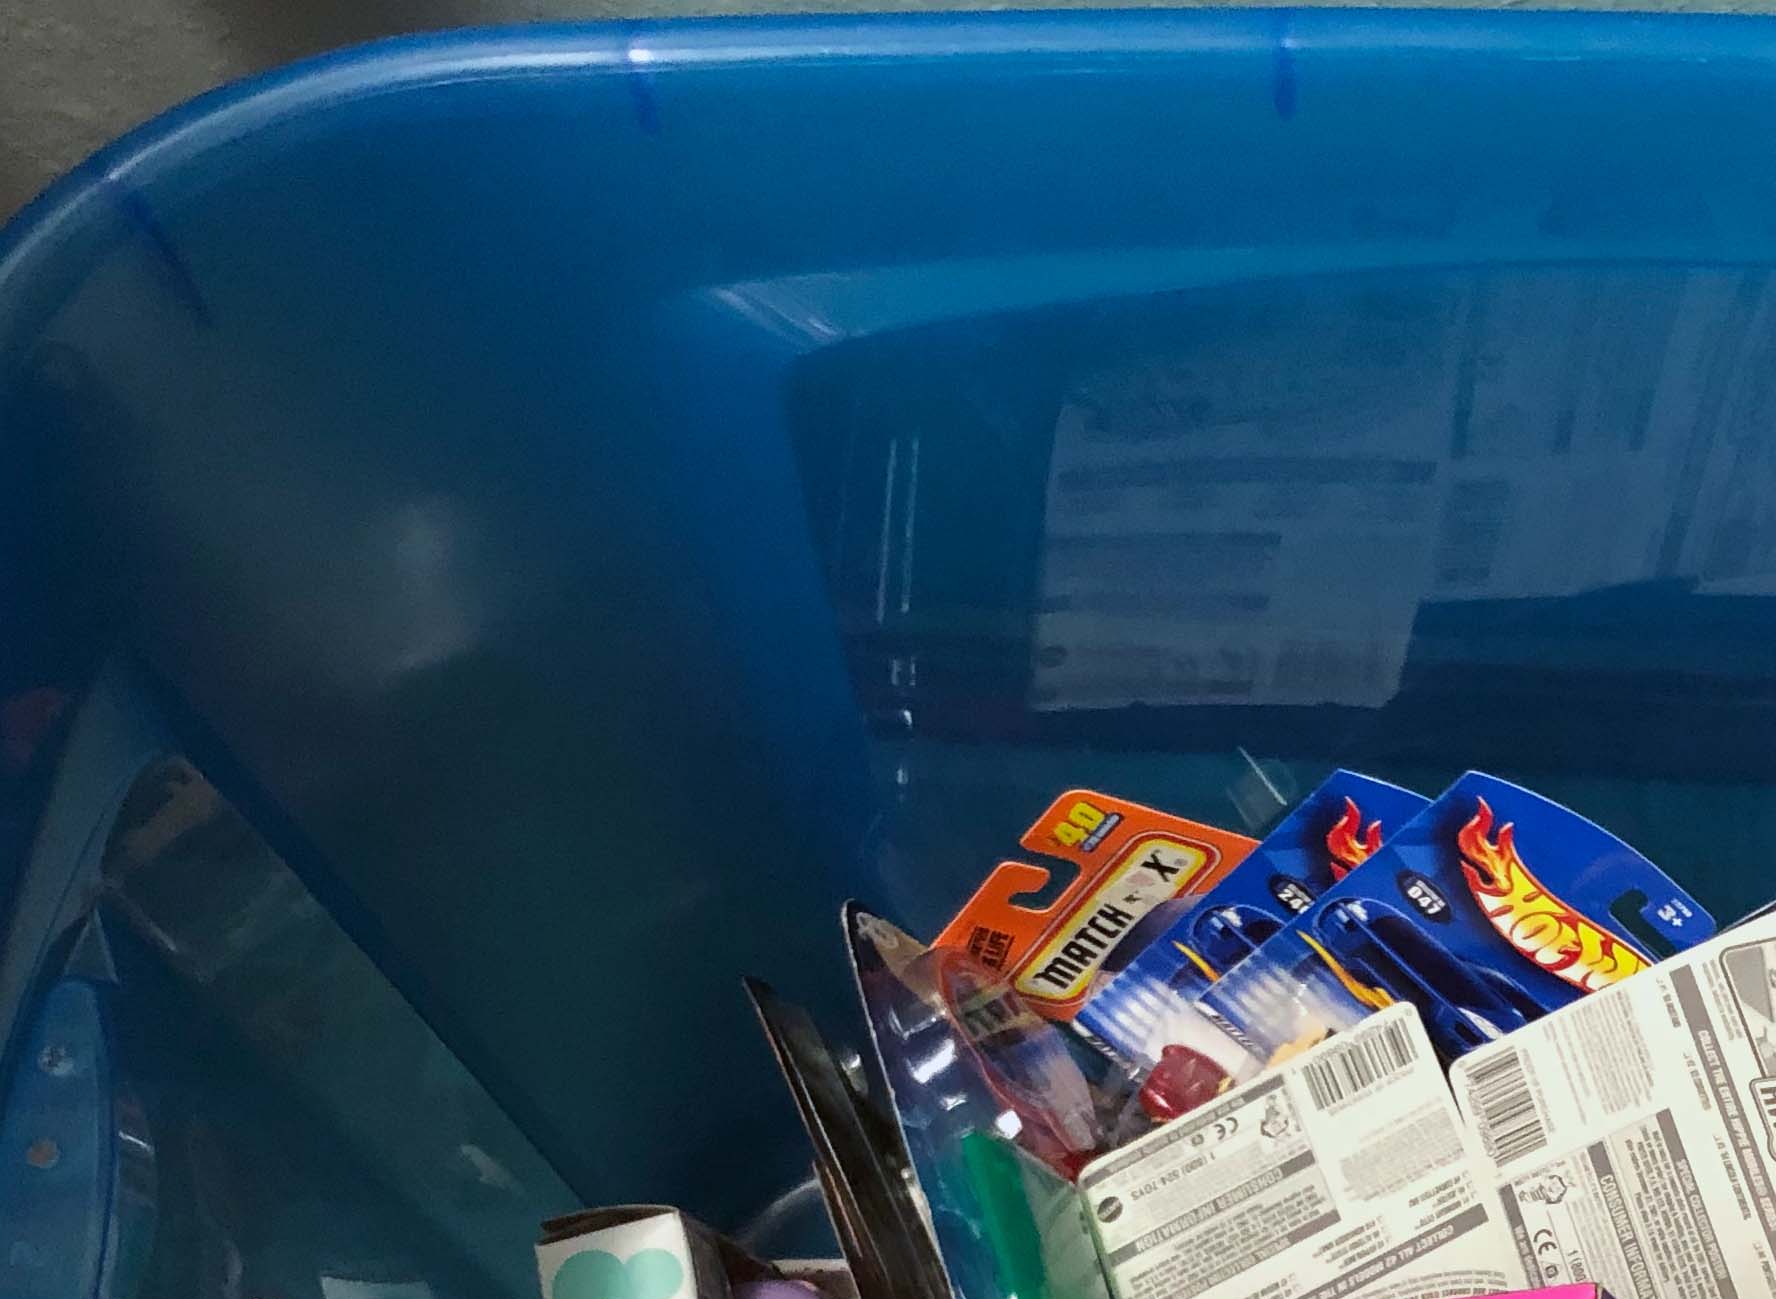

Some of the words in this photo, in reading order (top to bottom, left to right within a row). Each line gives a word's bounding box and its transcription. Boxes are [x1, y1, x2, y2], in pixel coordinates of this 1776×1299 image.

[1405, 882, 1442, 918] 047
[1656, 901, 1685, 930] 3+
[1711, 1067, 1726, 1086] THE
[1717, 1085, 1738, 1118] ENTIRE
[1215, 1165, 1284, 1211] CONSUMER
[1675, 1158, 1696, 1194] SPECIAL
[1688, 1193, 1714, 1243] COLLECTOR
[1598, 1173, 1635, 1244] CONSUMER
[1133, 1200, 1216, 1252] INFORMATION
[1413, 1222, 1455, 1252] COLLECT
[1396, 1242, 1414, 1260] ALL
